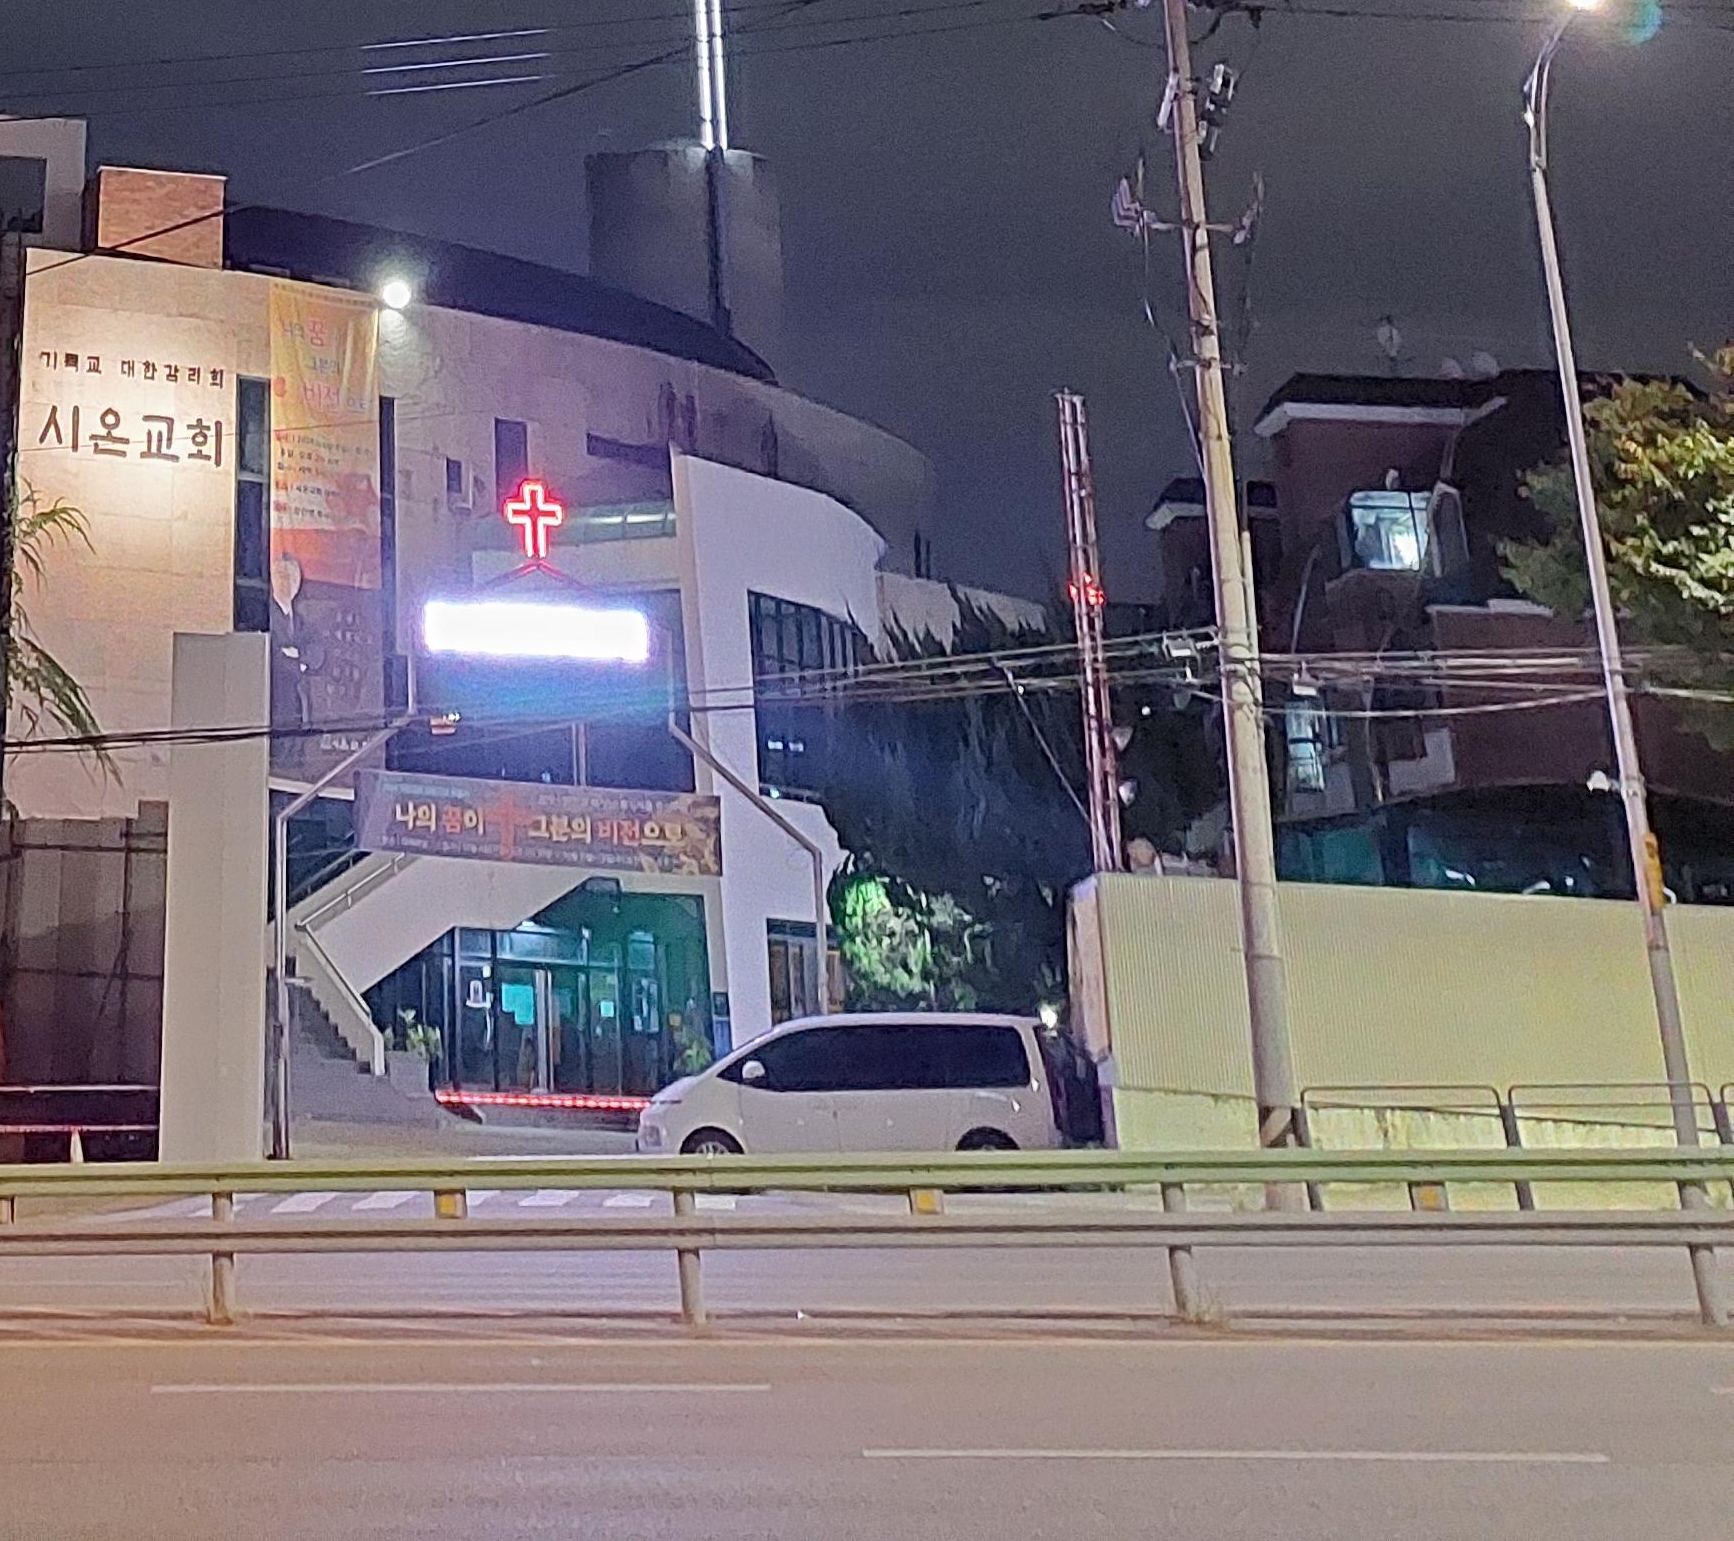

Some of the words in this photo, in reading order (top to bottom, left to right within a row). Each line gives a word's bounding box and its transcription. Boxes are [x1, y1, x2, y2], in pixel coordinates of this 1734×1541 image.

[40, 351, 102, 374] 기독교
[121, 360, 224, 390] 대한감리회
[38, 405, 223, 467] 시온교회
[395, 800, 437, 833] 나의
[442, 804, 485, 836] 꿈이
[528, 814, 592, 845] 그분의
[597, 819, 686, 849] 비전으로
